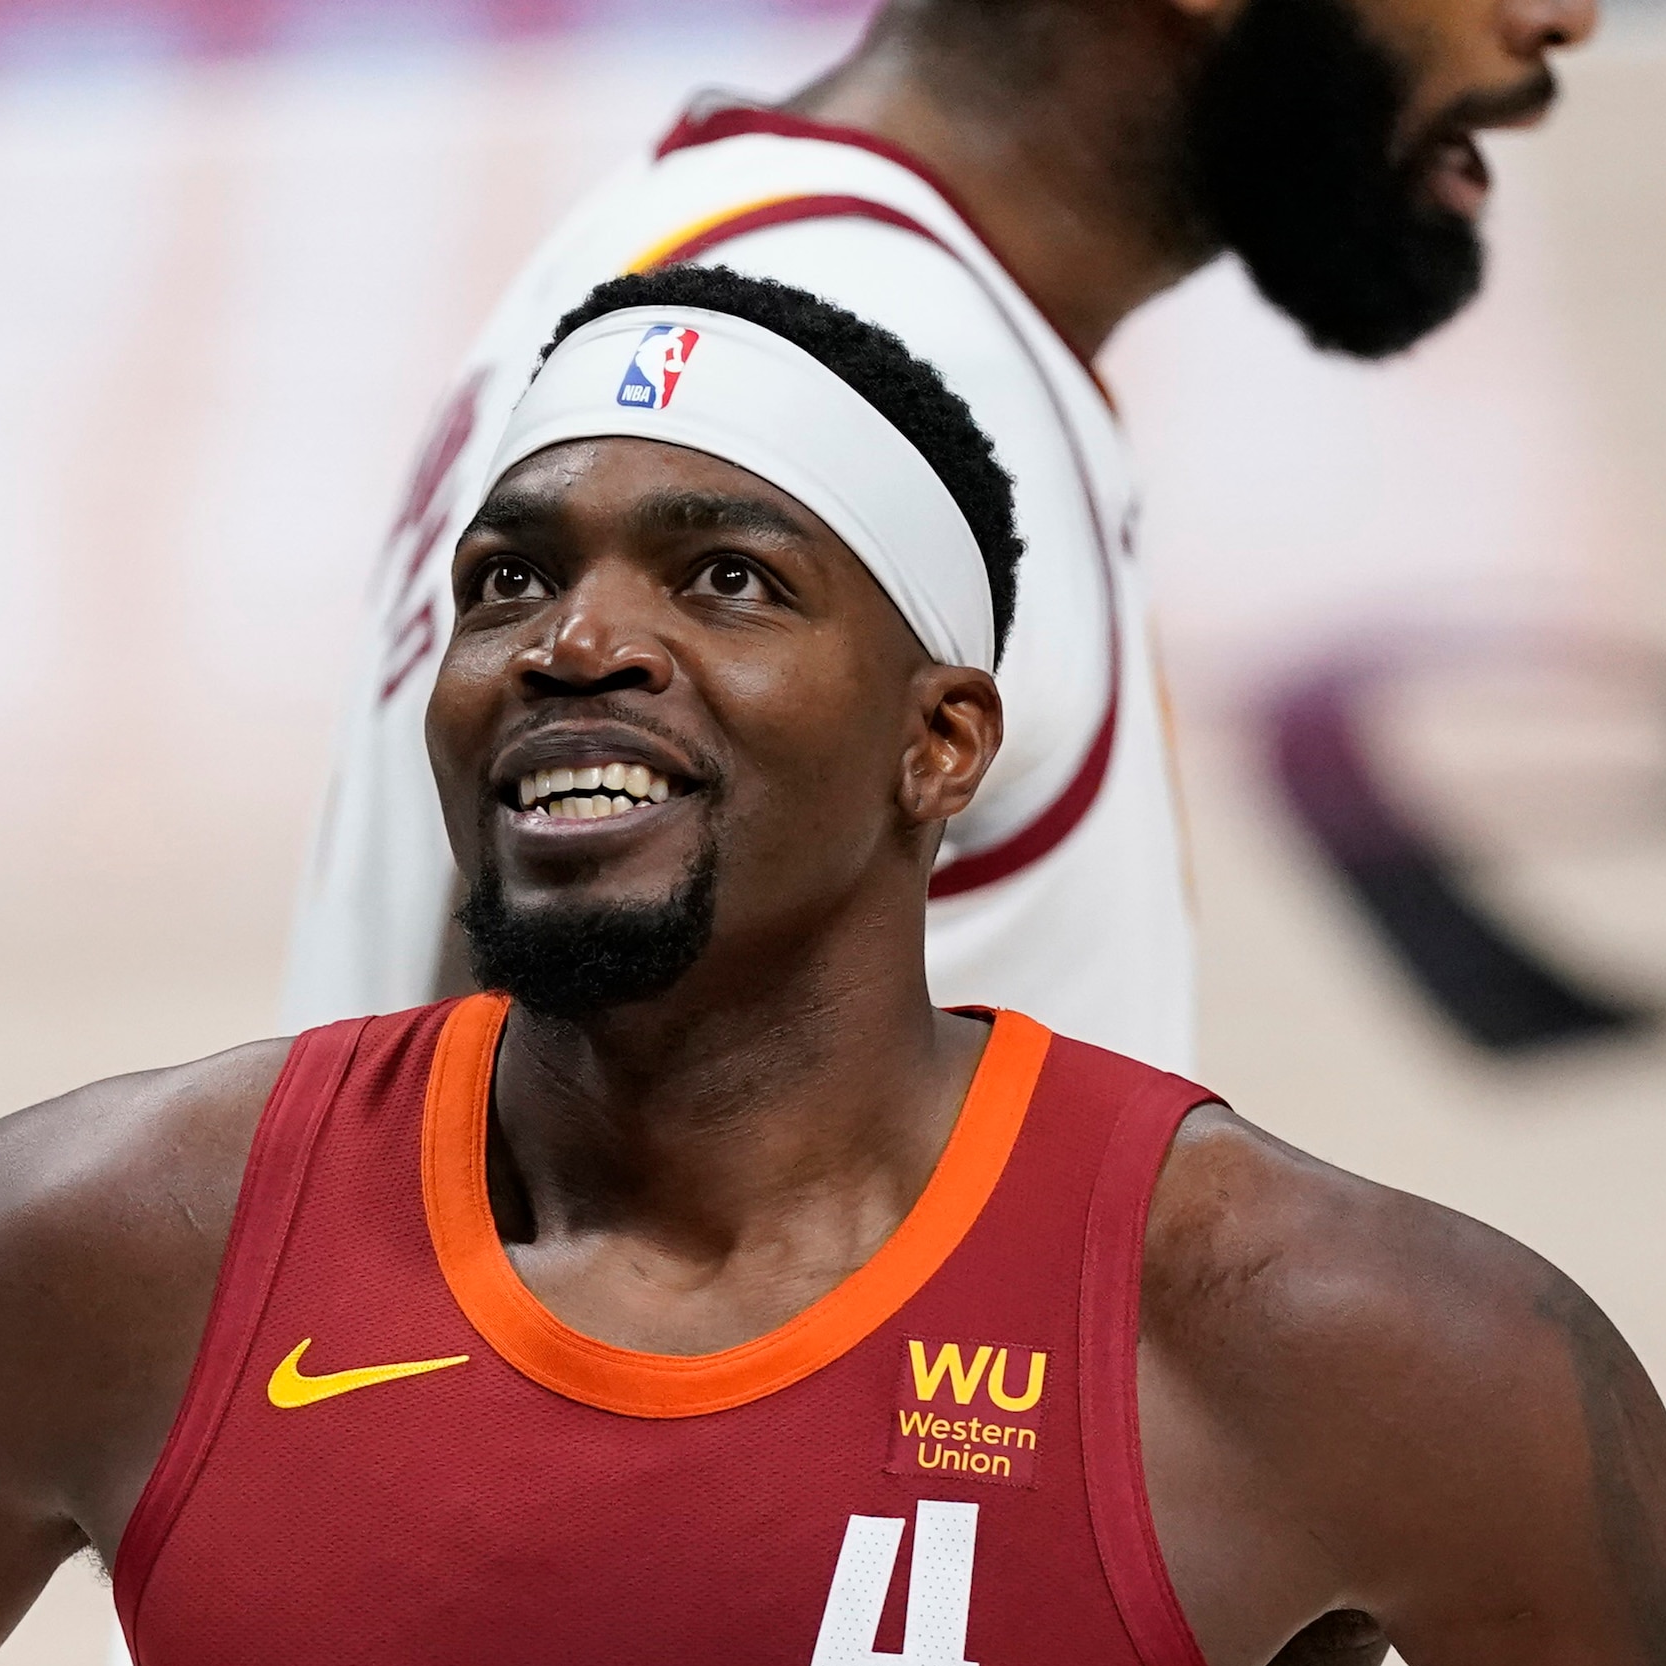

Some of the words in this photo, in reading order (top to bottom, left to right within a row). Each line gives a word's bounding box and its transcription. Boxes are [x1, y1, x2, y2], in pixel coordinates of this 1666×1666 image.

[621, 384, 651, 403] NBA
[908, 1339, 1047, 1413] WU
[898, 1409, 1036, 1450] Western
[917, 1441, 1011, 1477] Union
